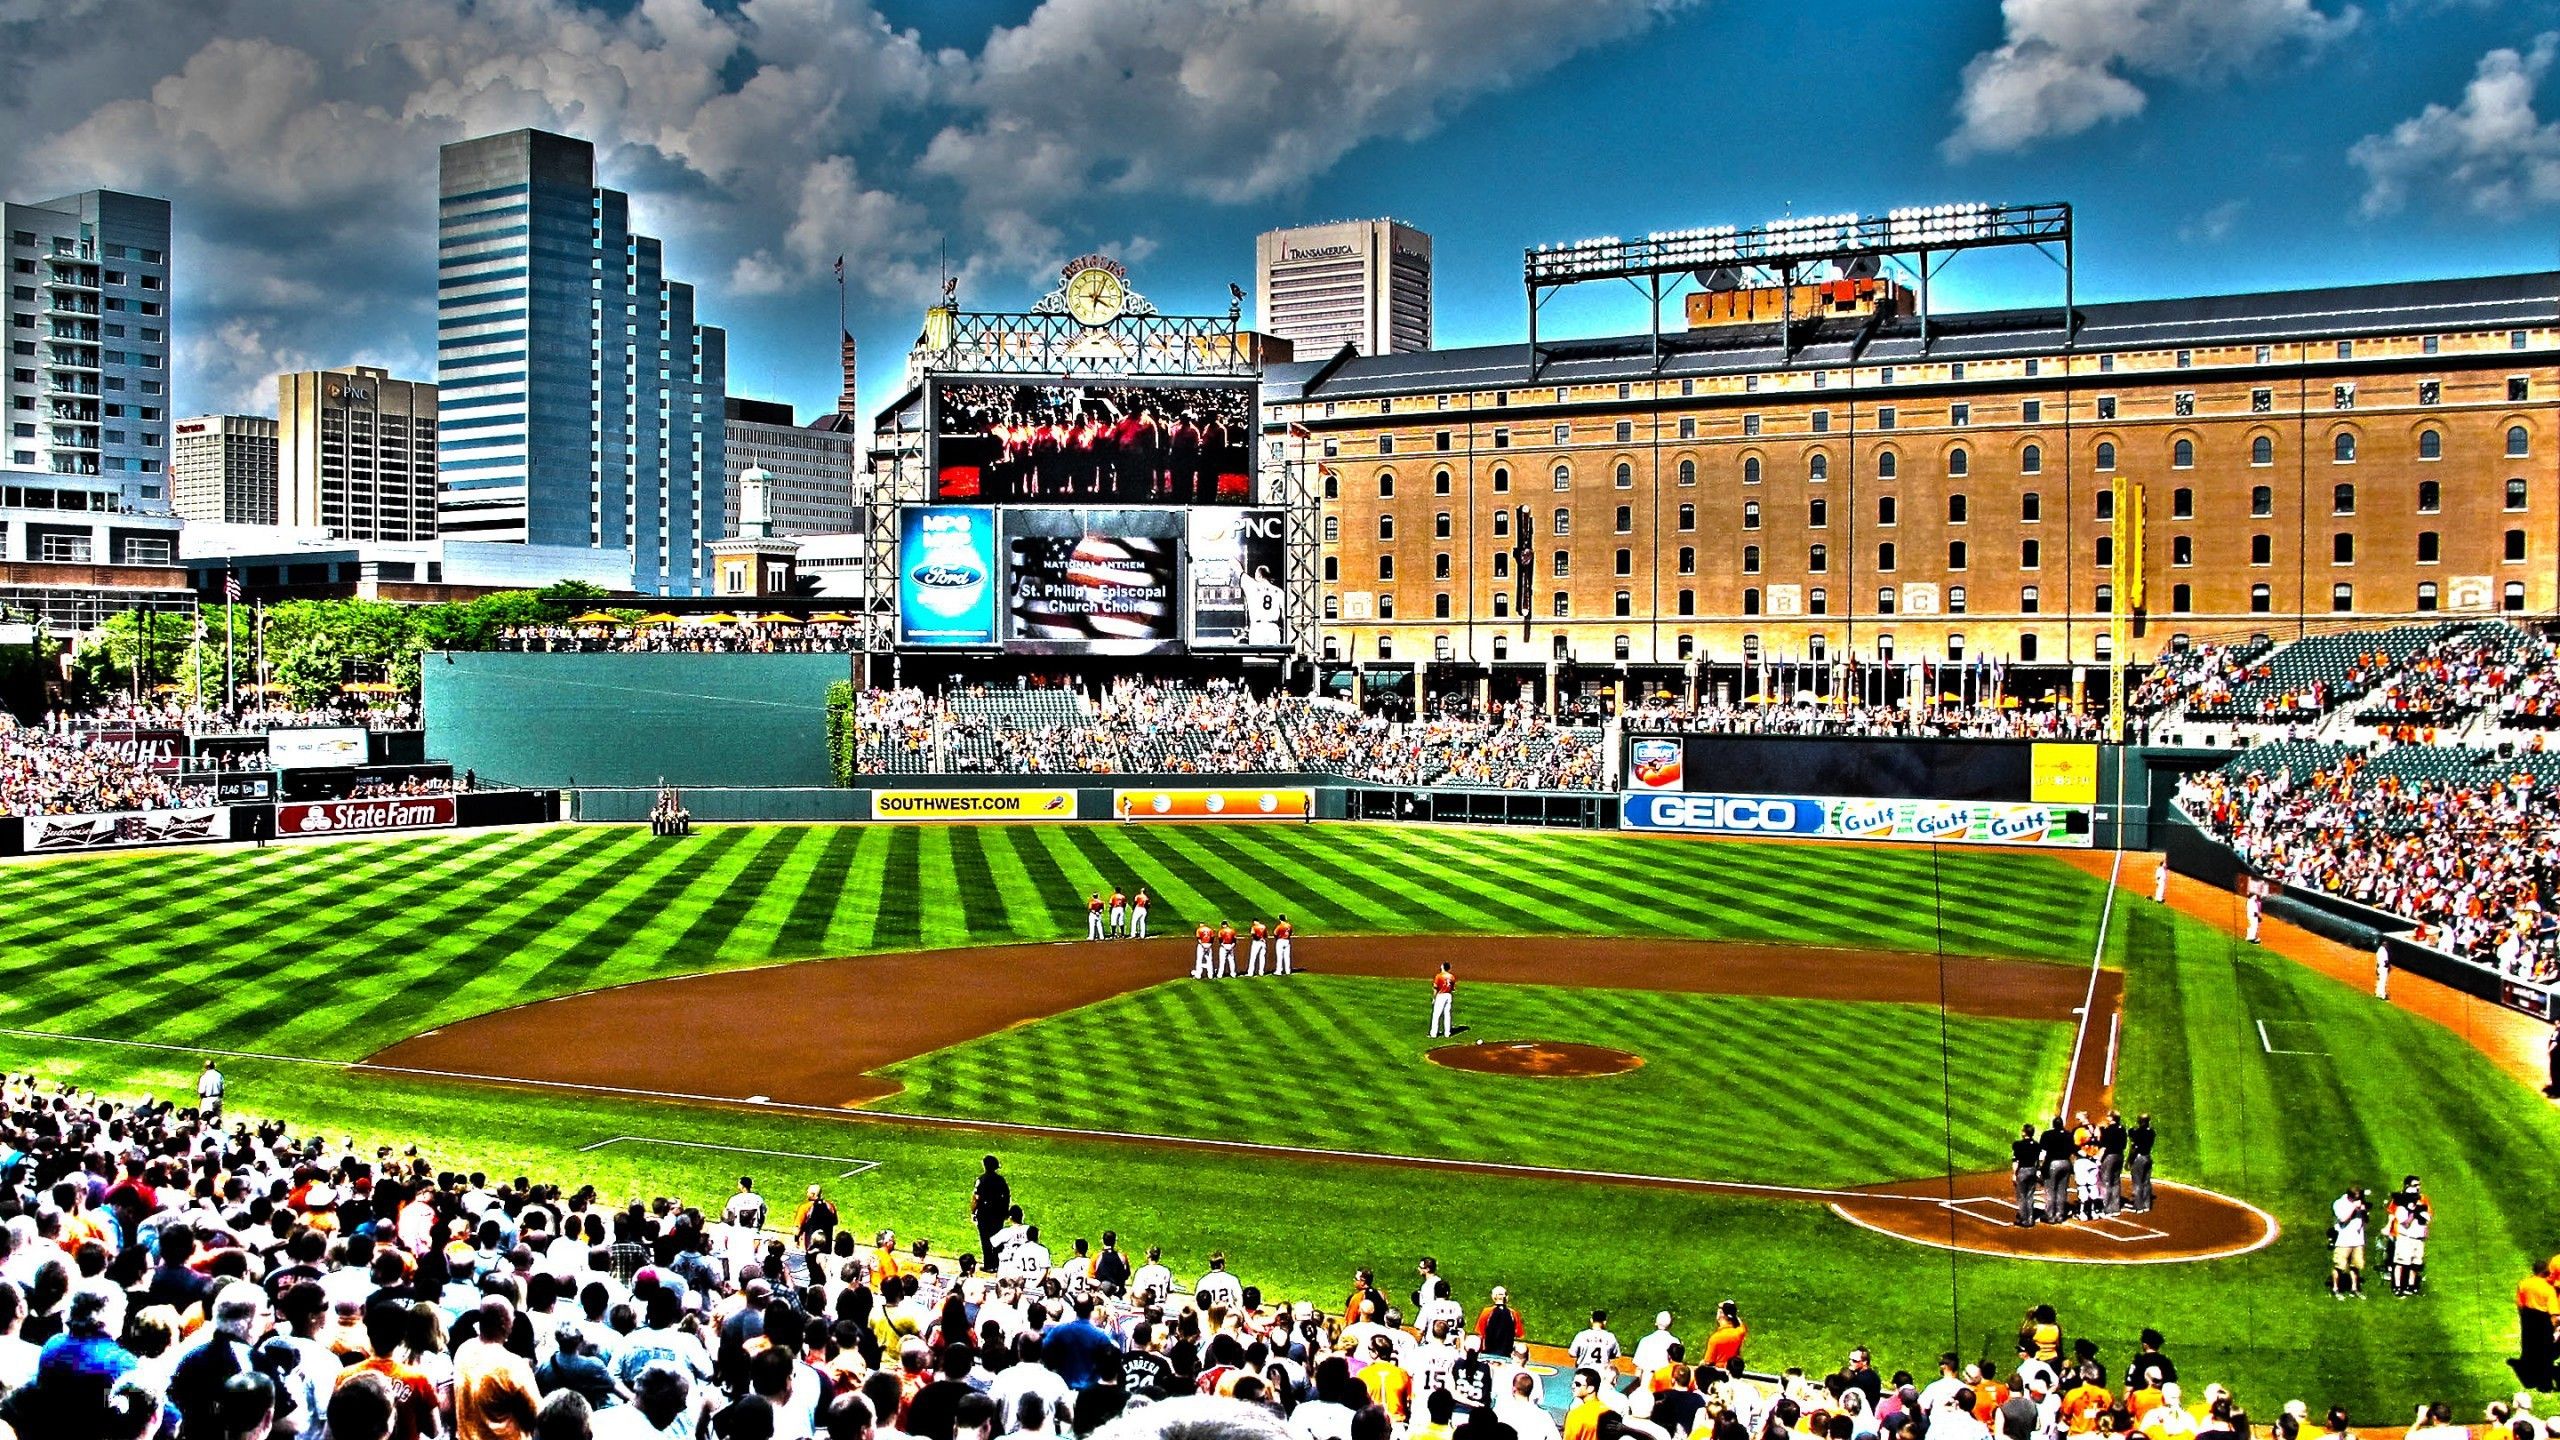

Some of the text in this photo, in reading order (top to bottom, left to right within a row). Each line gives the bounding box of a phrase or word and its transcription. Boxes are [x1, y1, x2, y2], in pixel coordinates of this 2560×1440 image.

[1290, 245, 1353, 259] TRANSAMERICA
[343, 384, 368, 400] PNC
[1232, 517, 1282, 539] PNC
[1044, 561, 1145, 569] NATIONAL ANTHEM
[924, 565, 970, 585] Ford
[1021, 584, 1041, 598] St.
[1099, 584, 1166, 600] Episcopal
[1049, 601, 1098, 613] Church
[1262, 594, 1272, 610] 8
[880, 797, 1020, 811] SOUTHWEST.COM
[1650, 796, 1796, 831] GEICO
[1844, 808, 1894, 831] Gulf
[1916, 810, 1968, 833] Gulf
[1991, 812, 2044, 836] Gulf
[1022, 1258, 1037, 1271] 13
[1211, 1288, 1229, 1302] 12
[1591, 1347, 1602, 1363] 4
[1123, 1360, 1160, 1375] CABRERA
[1125, 1374, 1155, 1391] 24
[1424, 1370, 1446, 1391] 15
